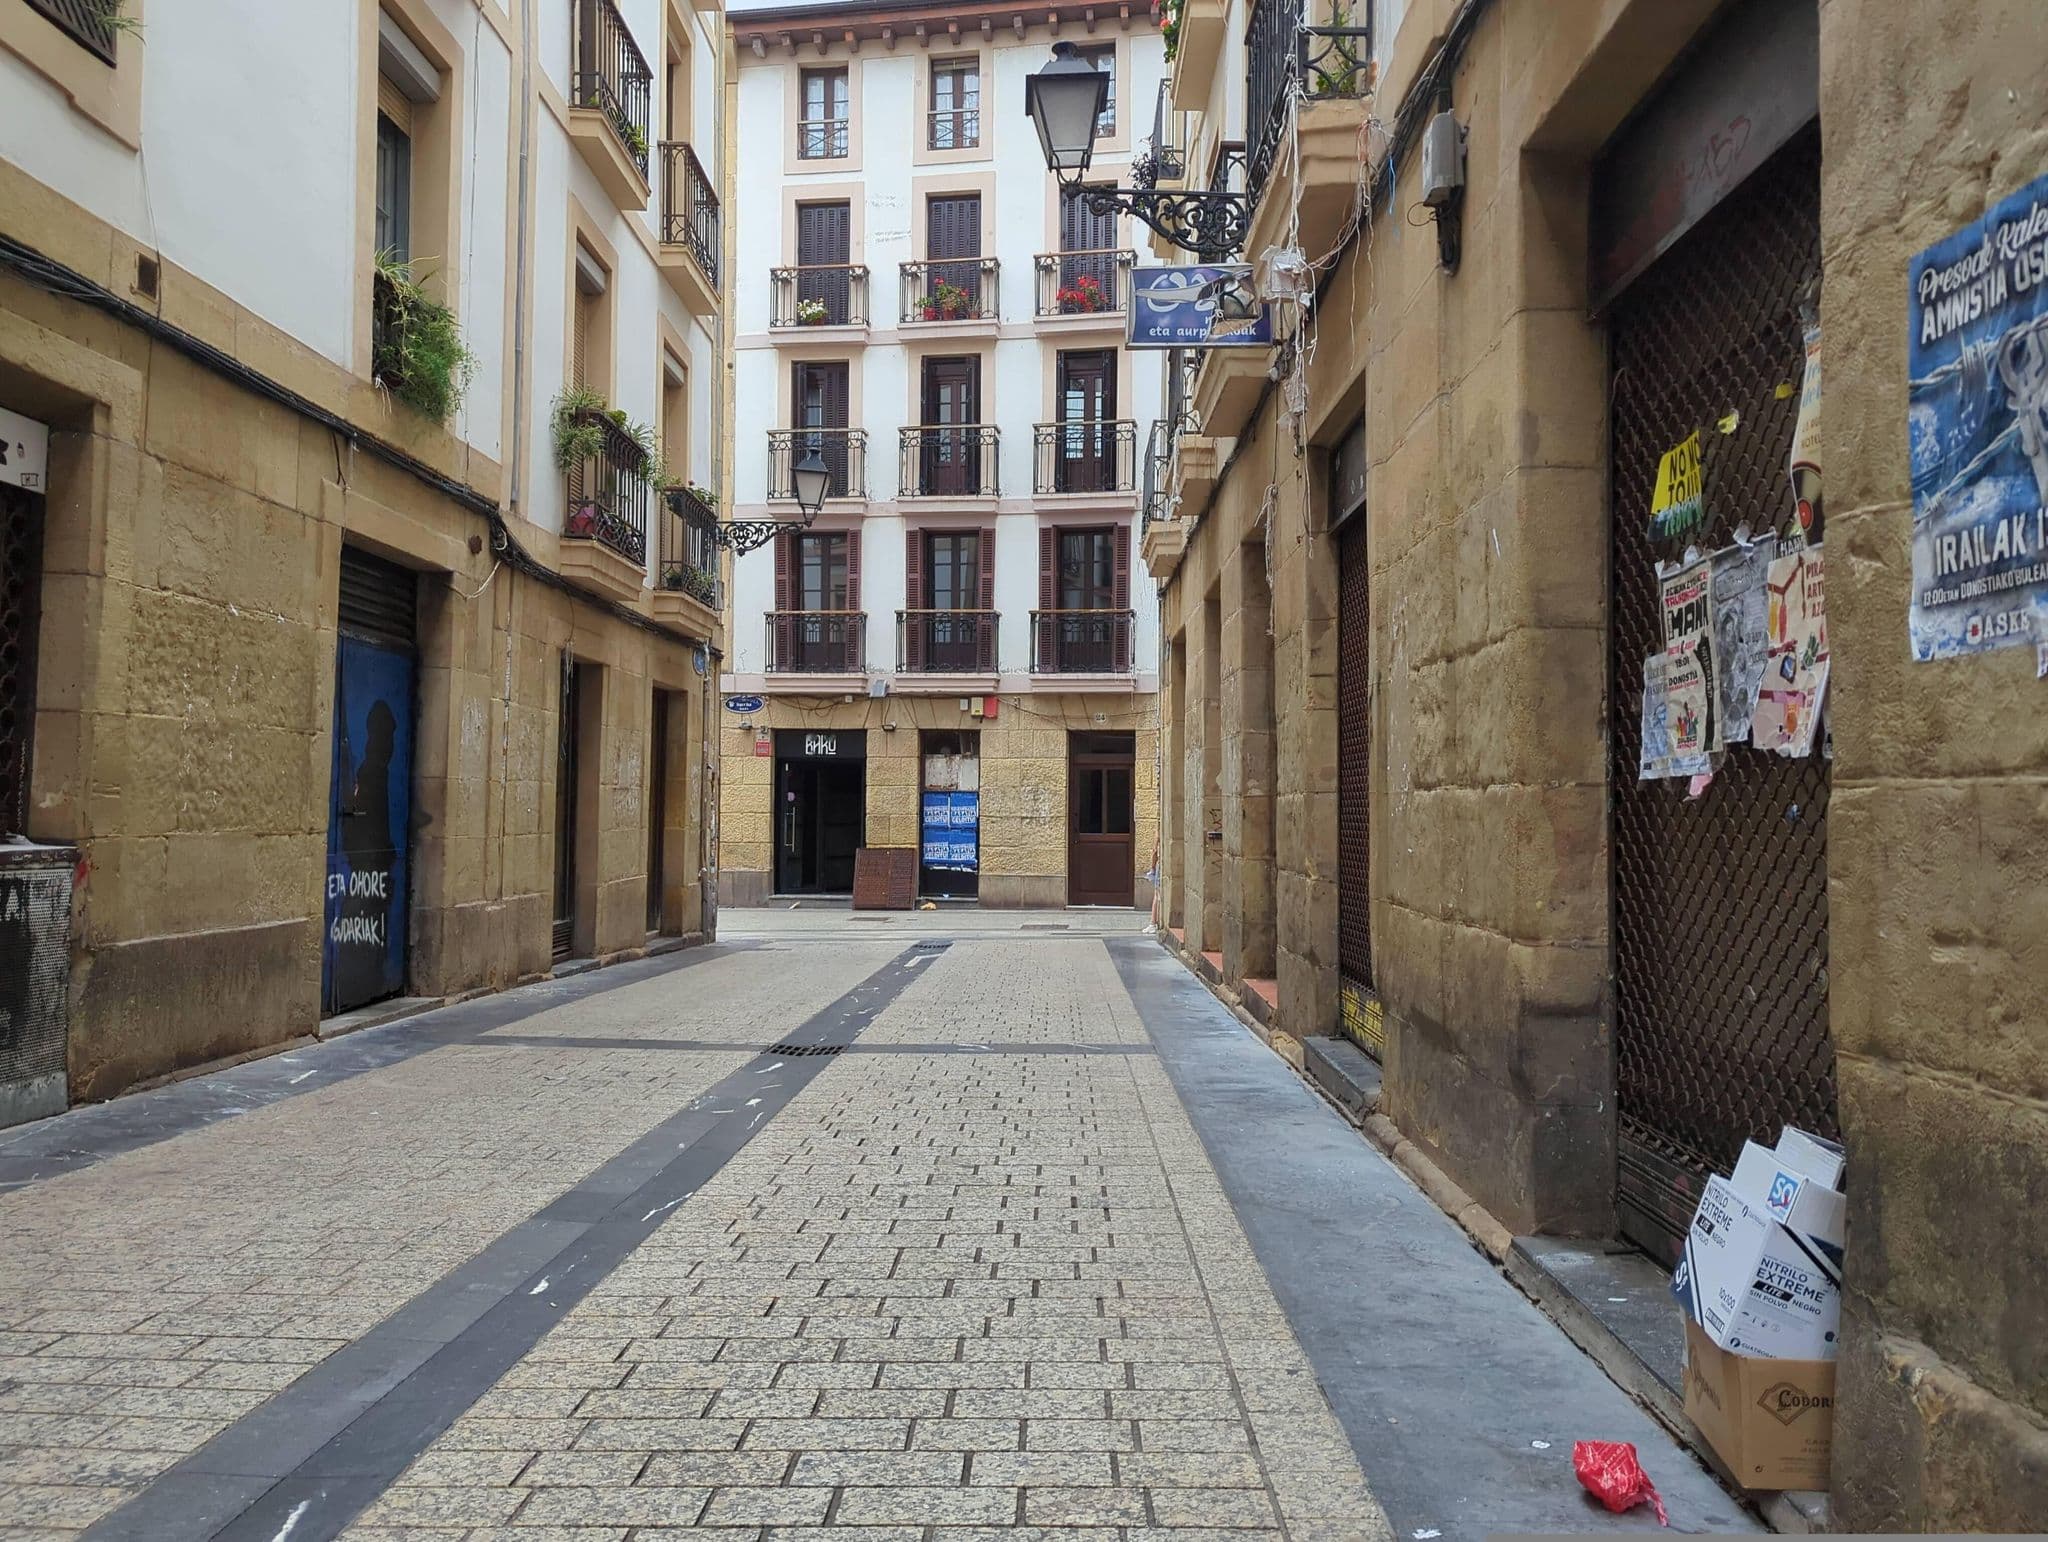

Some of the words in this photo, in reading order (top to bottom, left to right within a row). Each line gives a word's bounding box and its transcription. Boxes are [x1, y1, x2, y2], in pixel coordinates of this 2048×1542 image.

[1921, 263, 2008, 344] AMNISTIA
[1149, 326, 1170, 337] eta
[1670, 448, 1686, 482] NO
[1935, 512, 2027, 576] IRAILAK
[1668, 670, 1698, 687] DONOSTIA
[328, 872, 346, 899] ETA
[350, 870, 388, 899] OHORE
[1706, 1183, 1729, 1209] NITRILO
[1701, 1197, 1733, 1232] EXTREME
[1756, 1267, 1826, 1303] EXTREME
[1761, 1257, 1808, 1284] NITRILO
[1749, 1289, 1761, 1299] SIN
[1763, 1295, 1788, 1310] POLVO
[1762, 1283, 1785, 1298] LITE
[1793, 1299, 1821, 1316] NEGRO
